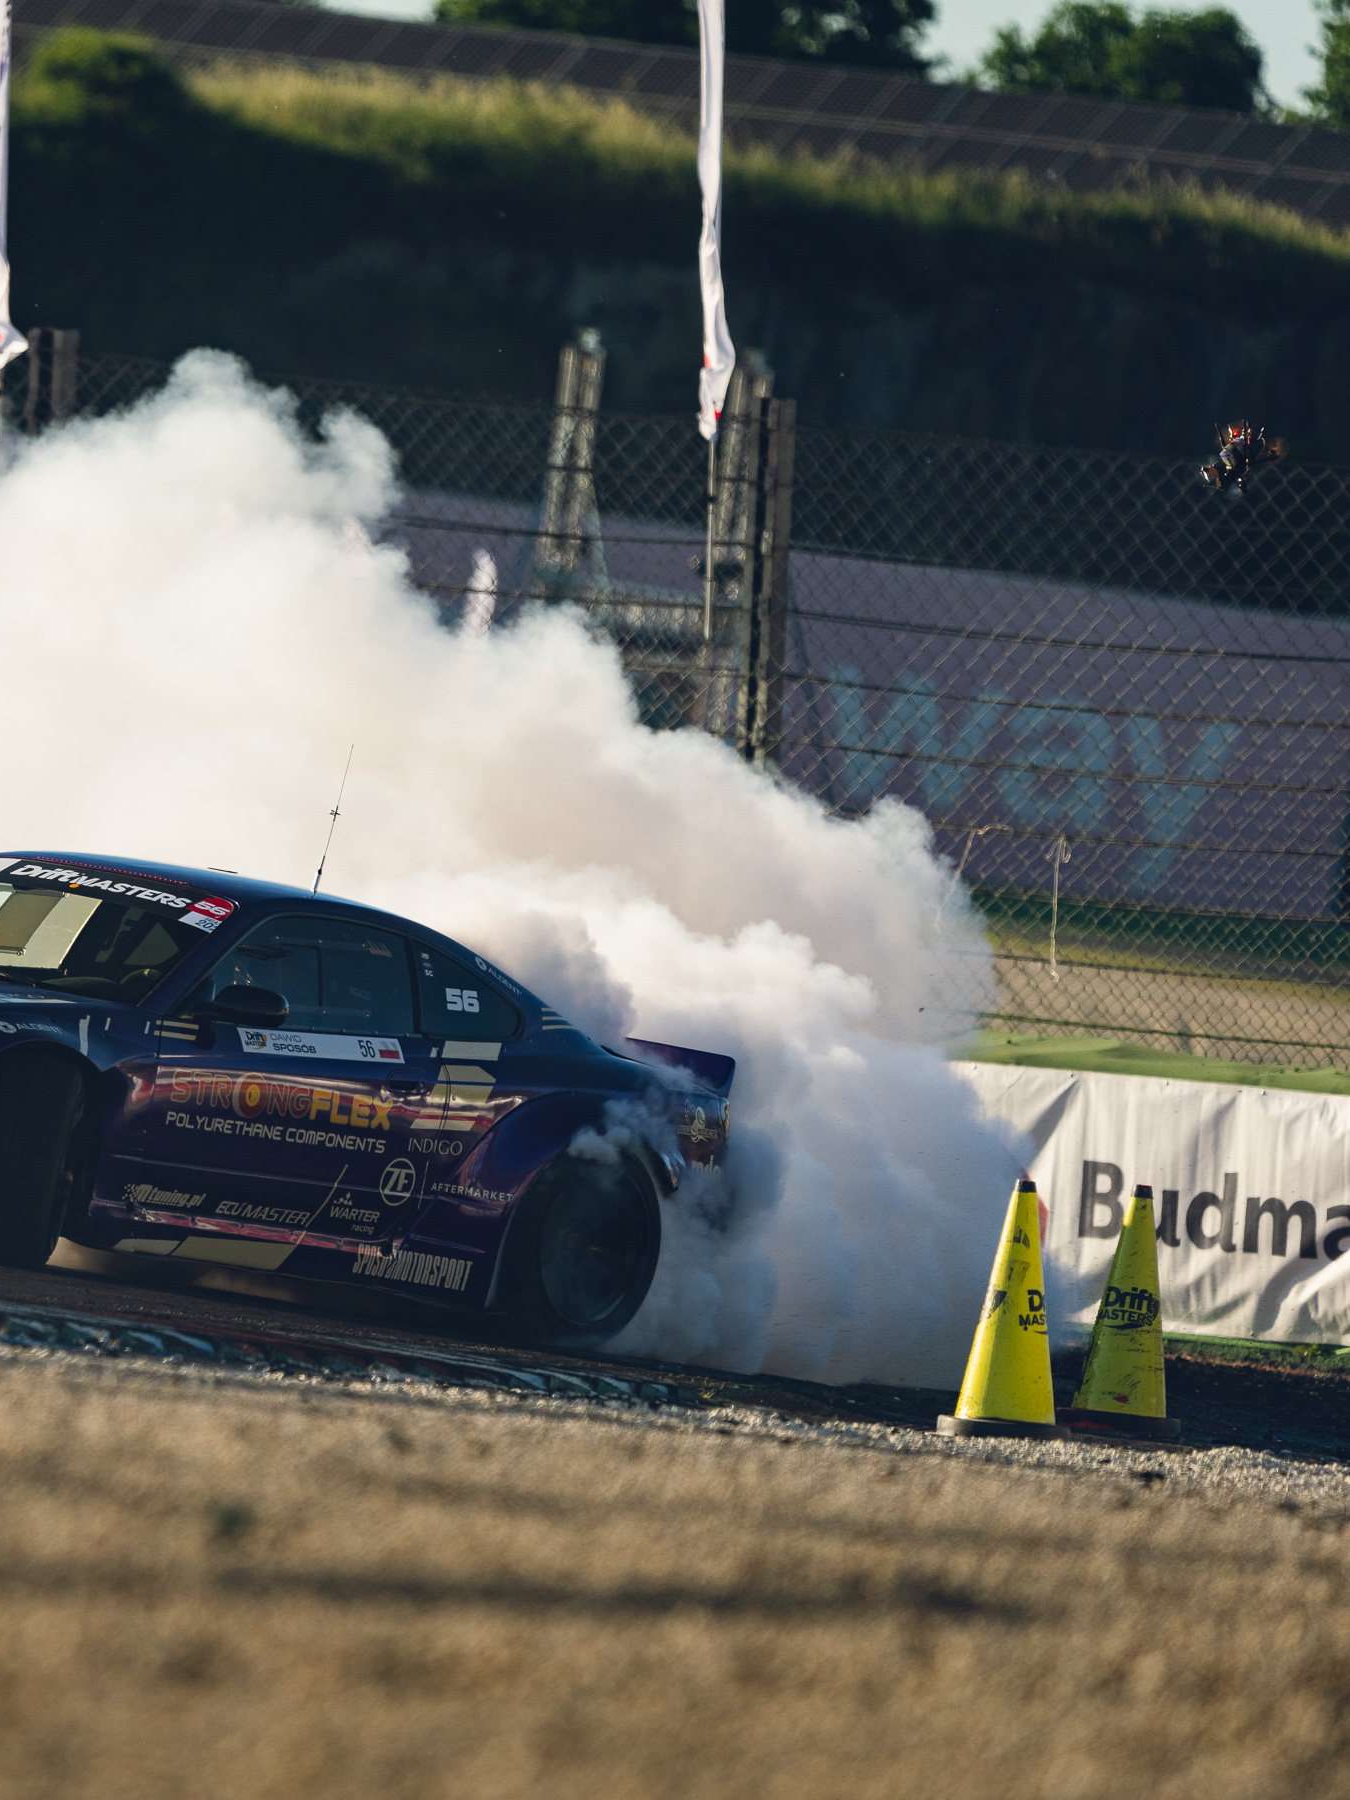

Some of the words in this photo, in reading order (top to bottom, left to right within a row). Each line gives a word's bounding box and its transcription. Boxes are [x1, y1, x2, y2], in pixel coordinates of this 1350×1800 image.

[194, 901, 230, 916] 56
[488, 967, 523, 997] ALDENT
[445, 987, 480, 1014] 56
[16, 1022, 63, 1035] ALDENT
[245, 1030, 265, 1042] Drift
[269, 1033, 303, 1043] DAWID
[272, 1042, 317, 1054] SPOSÓB
[357, 1039, 376, 1059] 56
[170, 1070, 394, 1132] STRONGFLEX
[165, 1111, 284, 1141] POLYURETHANE
[285, 1127, 387, 1154] COMPONENTS
[407, 1137, 463, 1156] INDIGO
[383, 1168, 416, 1197] ZF
[431, 1182, 514, 1204] AFTERMARKET
[329, 1206, 381, 1224] WARTER
[351, 1224, 375, 1235] racing
[1104, 1286, 1154, 1315] Drift
